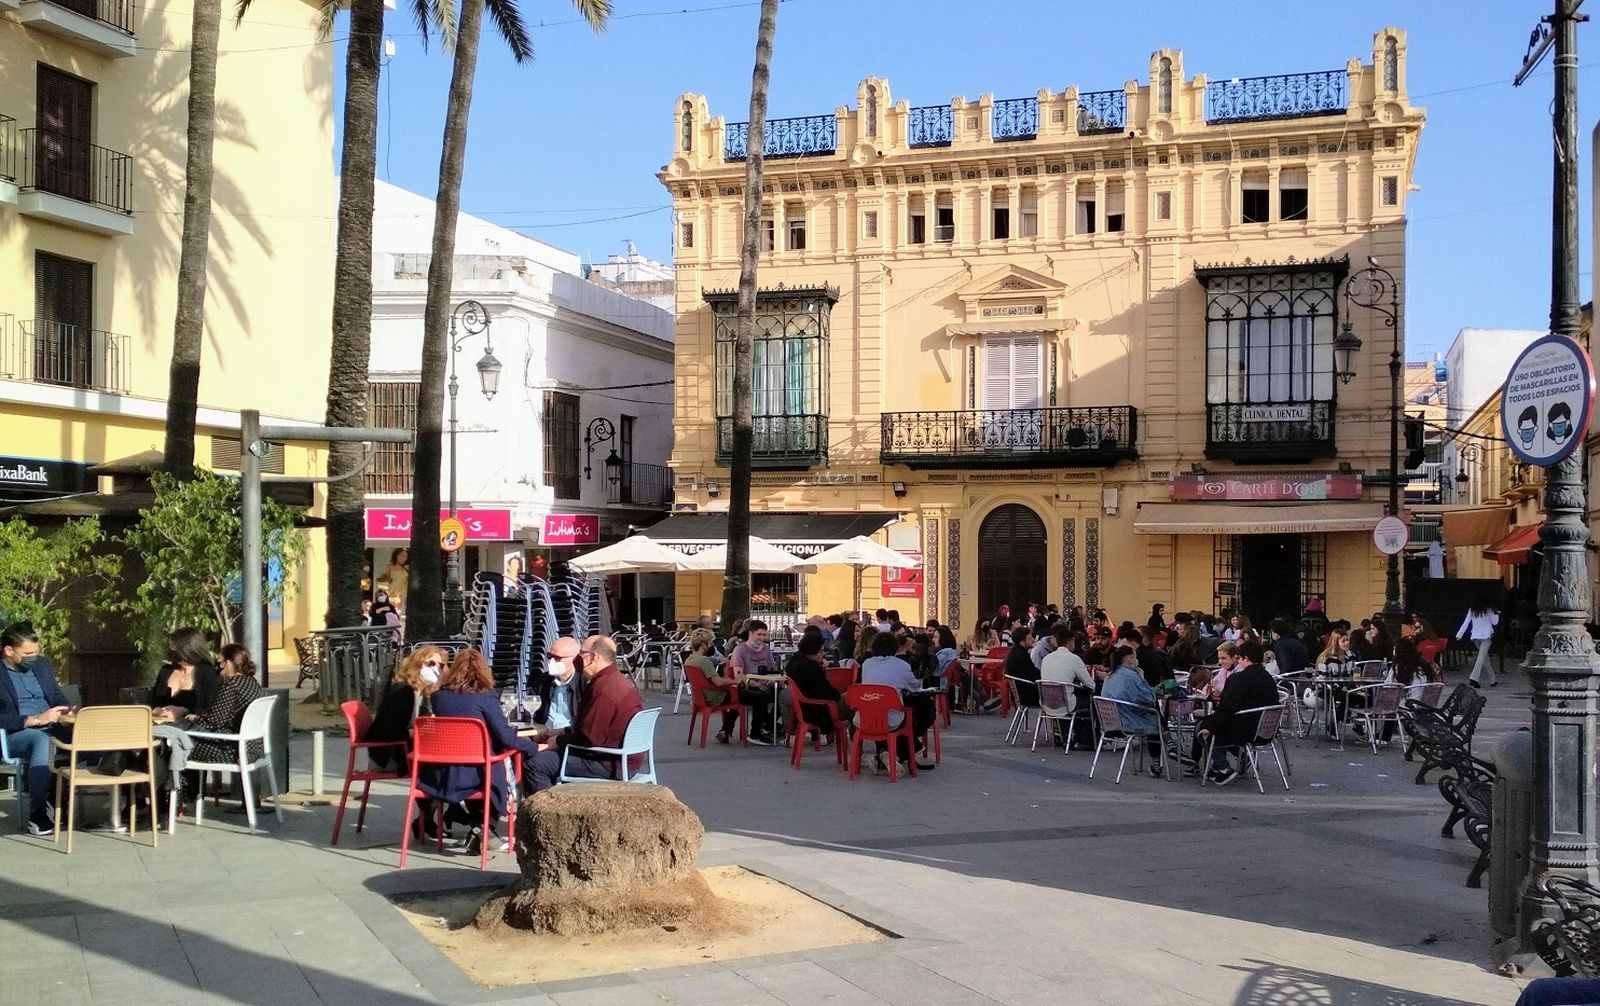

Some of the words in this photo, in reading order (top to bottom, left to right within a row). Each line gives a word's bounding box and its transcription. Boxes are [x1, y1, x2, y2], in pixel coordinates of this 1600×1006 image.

[1515, 373, 1529, 381] USO
[1530, 363, 1576, 378] OBLIGATORIO
[1510, 385, 1519, 393] DE
[1520, 375, 1567, 390] MASCARILLAS
[1569, 373, 1578, 381] EN
[1509, 393, 1531, 403] TODOS
[1532, 390, 1545, 399] LOS
[1546, 384, 1580, 397] ESPACIOS
[1277, 409, 1305, 418] DENTAL
[1231, 480, 1275, 497] CARTE
[1282, 480, 1320, 497] D'OR
